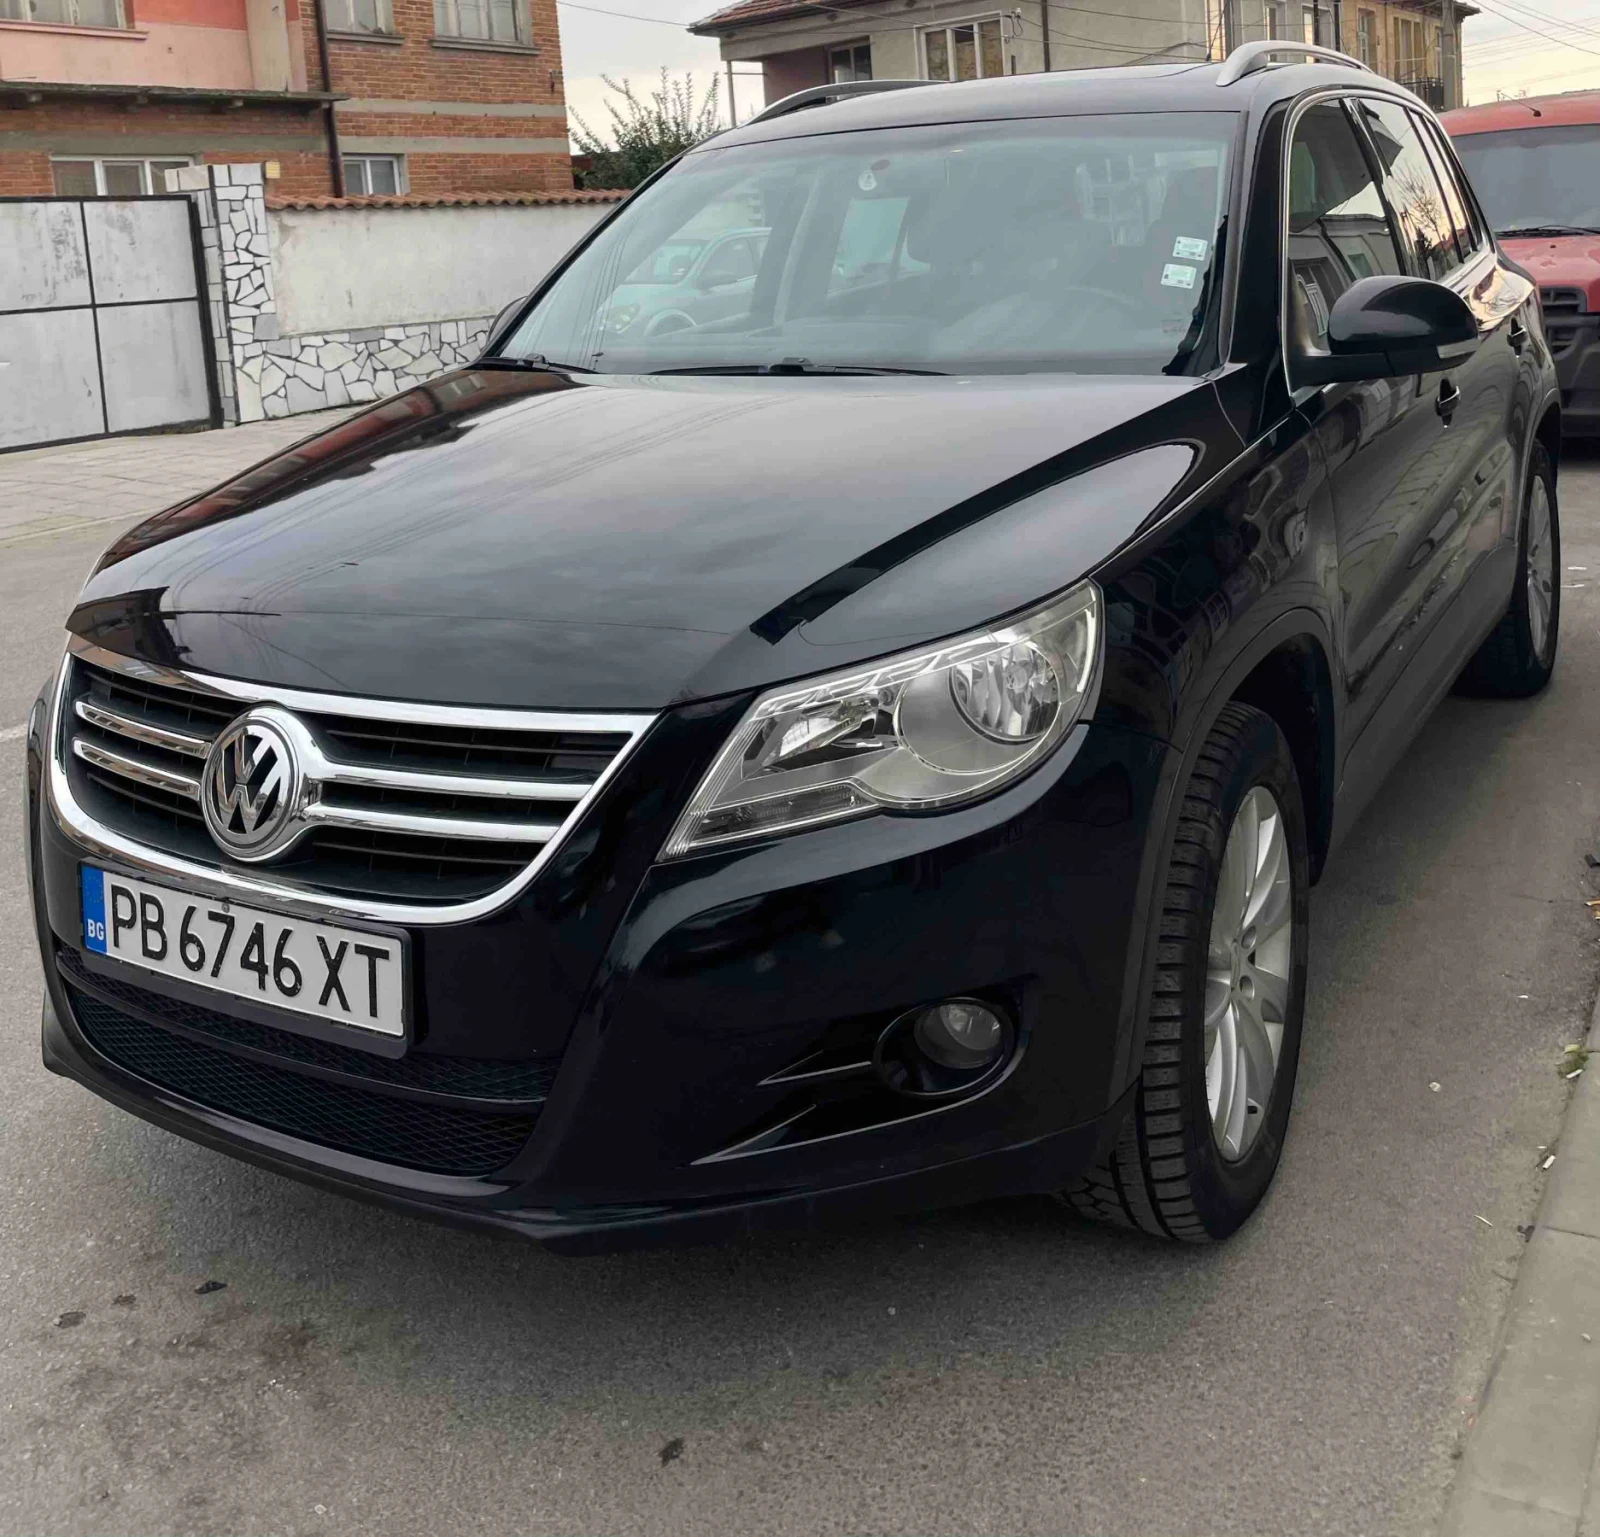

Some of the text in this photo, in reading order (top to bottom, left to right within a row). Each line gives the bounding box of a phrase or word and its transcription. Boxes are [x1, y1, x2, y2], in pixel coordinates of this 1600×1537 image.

[87, 919, 105, 941] BG
[111, 884, 390, 1018] PB 6746 XT
